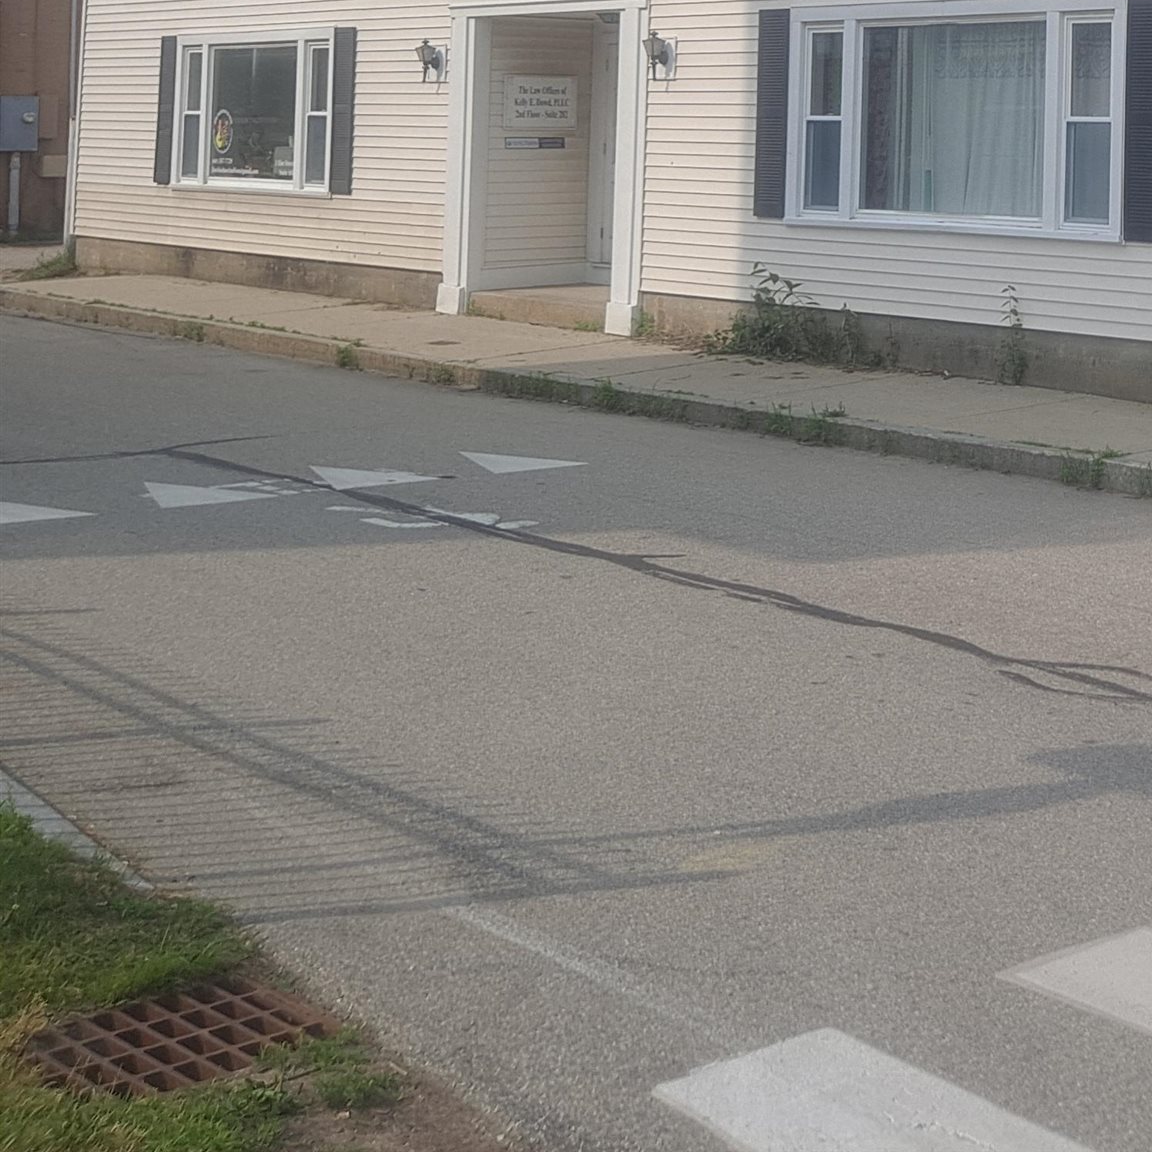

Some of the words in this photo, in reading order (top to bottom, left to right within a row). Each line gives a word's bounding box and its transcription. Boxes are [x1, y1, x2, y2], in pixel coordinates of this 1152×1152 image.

[519, 86, 528, 95] The
[529, 86, 541, 95] Law
[542, 86, 560, 95] Offices
[561, 86, 567, 95] of
[515, 98, 528, 108] Kelly
[554, 98, 569, 107] PLLC
[515, 110, 525, 118] 2nd
[527, 110, 540, 118] Floor
[545, 110, 558, 118] Suite
